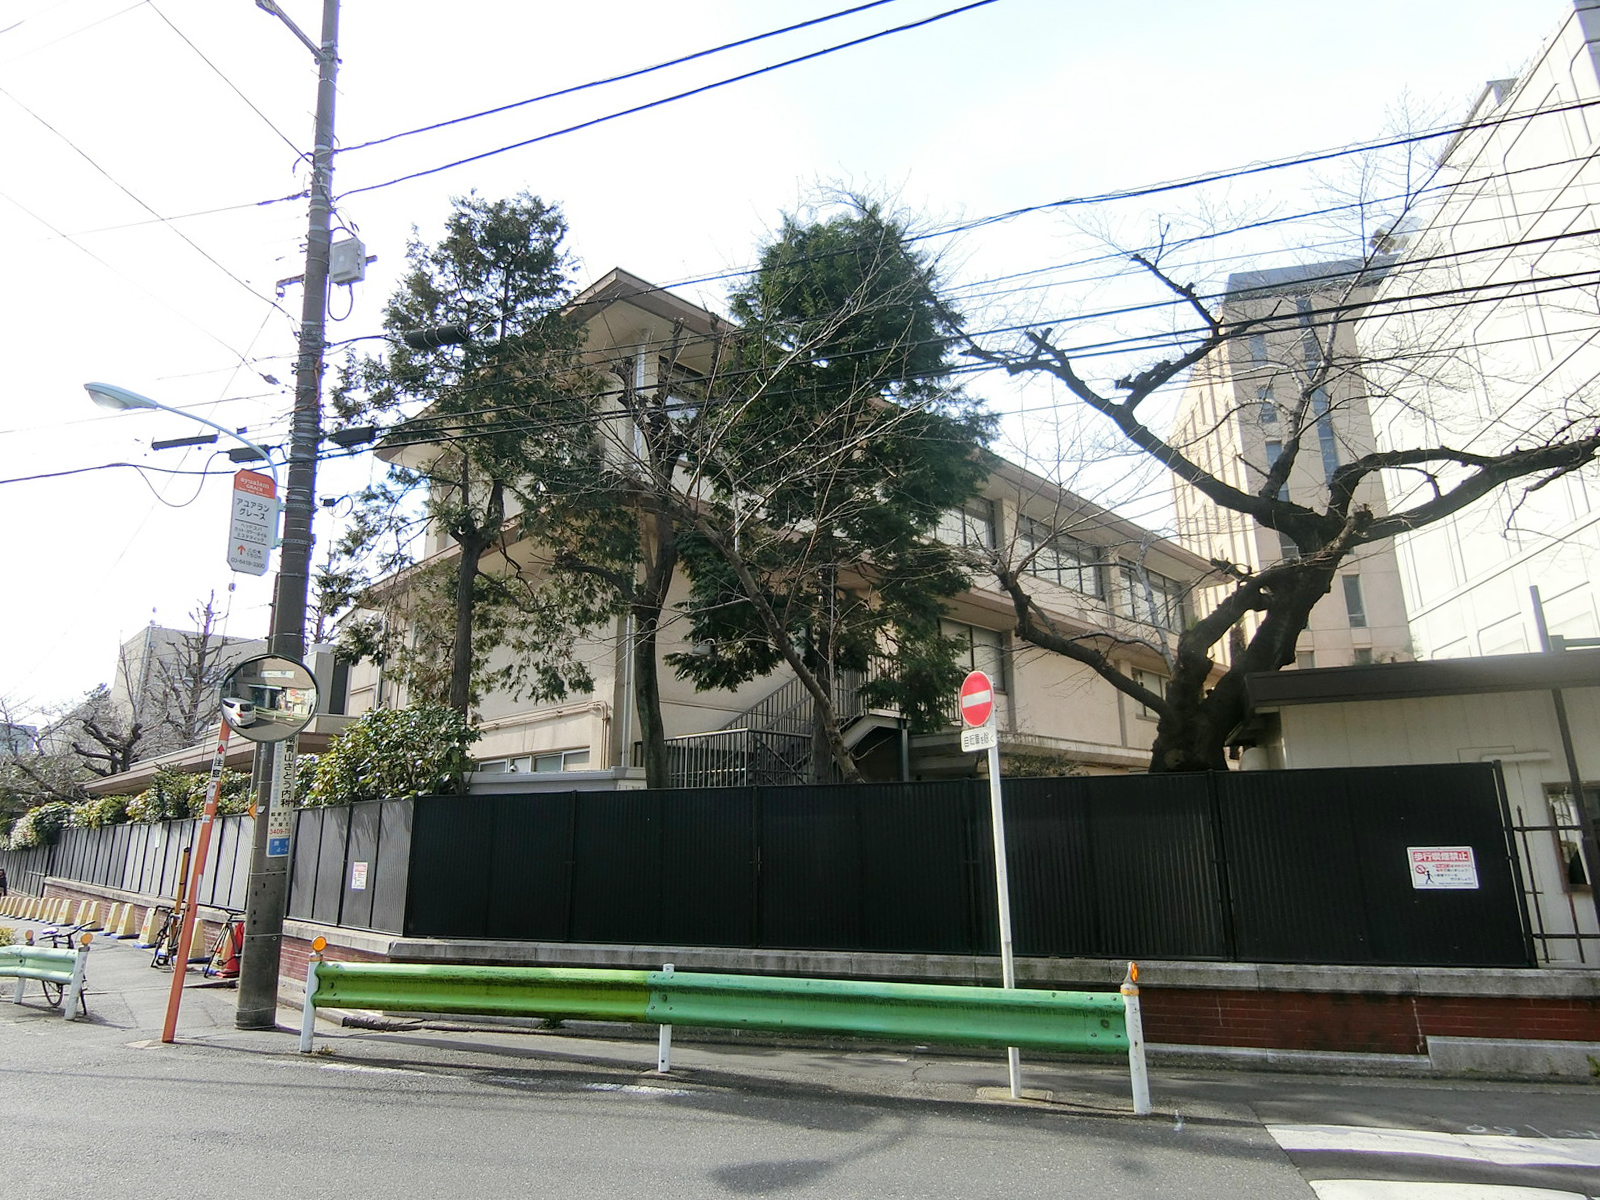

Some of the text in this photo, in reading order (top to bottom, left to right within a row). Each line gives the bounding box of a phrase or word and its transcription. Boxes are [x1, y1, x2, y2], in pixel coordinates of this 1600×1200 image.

[236, 498, 270, 512] アユアラン
[239, 508, 266, 521] グレース
[964, 732, 994, 748] 自転車を除く
[212, 758, 224, 778] 注意
[1414, 852, 1468, 862] 歩行喫煙禁止
